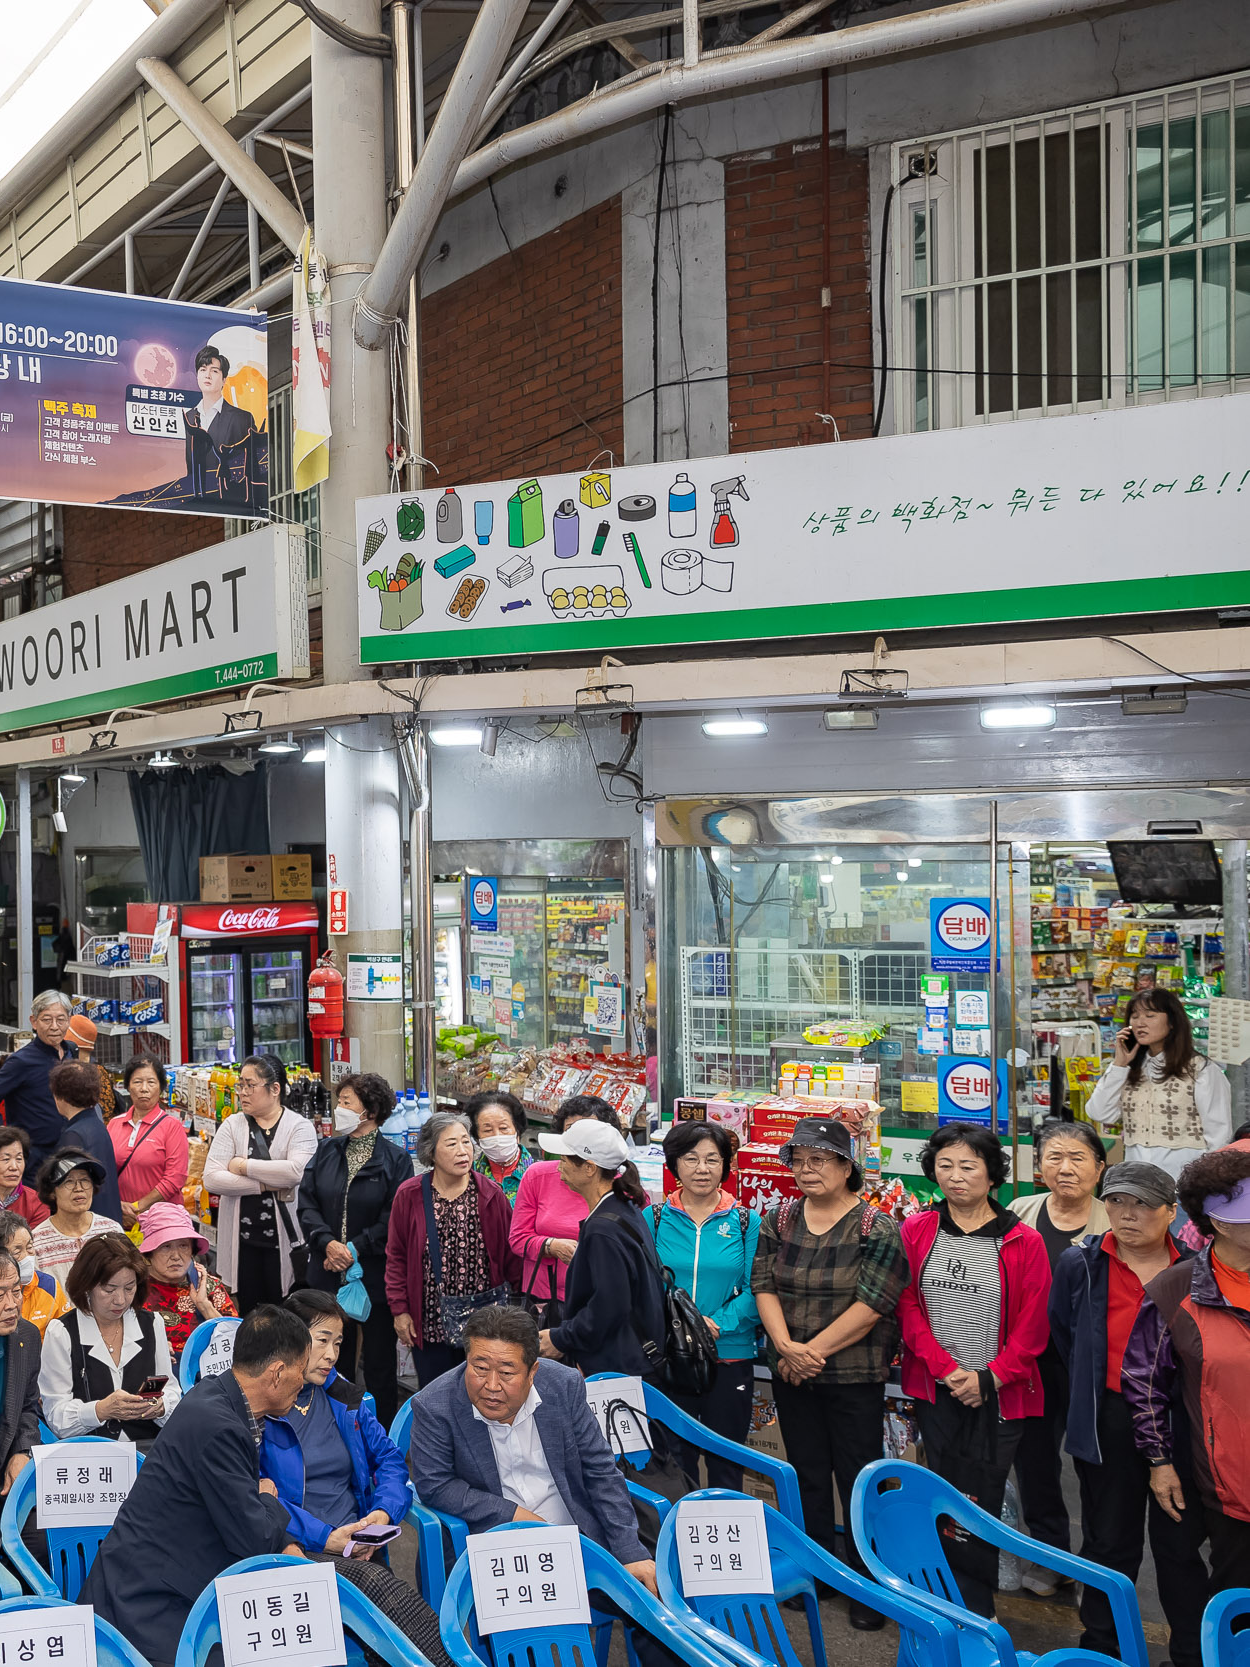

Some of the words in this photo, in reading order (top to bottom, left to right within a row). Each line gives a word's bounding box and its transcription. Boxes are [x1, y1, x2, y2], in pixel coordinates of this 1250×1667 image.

[18, 355, 42, 383] 내
[132, 387, 149, 399] 특별
[150, 389, 167, 401] 초청
[168, 391, 185, 403] 가수
[43, 400, 69, 416] 맥주
[71, 402, 97, 419] 축제
[131, 403, 158, 416] 미스터
[159, 406, 177, 418] 트롯
[1, 413, 14, 423] (금)
[44, 417, 60, 427] 고객
[62, 417, 94, 431] 경품추첨
[95, 421, 120, 433] 이벤트
[1, 423, 9, 433] 시
[44, 428, 60, 440] 고객
[62, 430, 78, 441] 참여
[79, 432, 112, 445] 노래자랑
[44, 452, 61, 463] 간식
[62, 453, 79, 465] 체험
[80, 455, 97, 466] 부스
[802, 504, 880, 537] 상품의
[1079, 485, 1107, 503] 다
[124, 566, 246, 661] MART
[215, 660, 264, 684] T.444-0772
[475, 890, 493, 905] 담배
[943, 917, 987, 936] 담배
[742, 1176, 773, 1190] 나의
[932, 1280, 980, 1293] DIDOT
[45, 1492, 95, 1505] 중곡제일시장
[99, 1492, 127, 1502] 조합장
